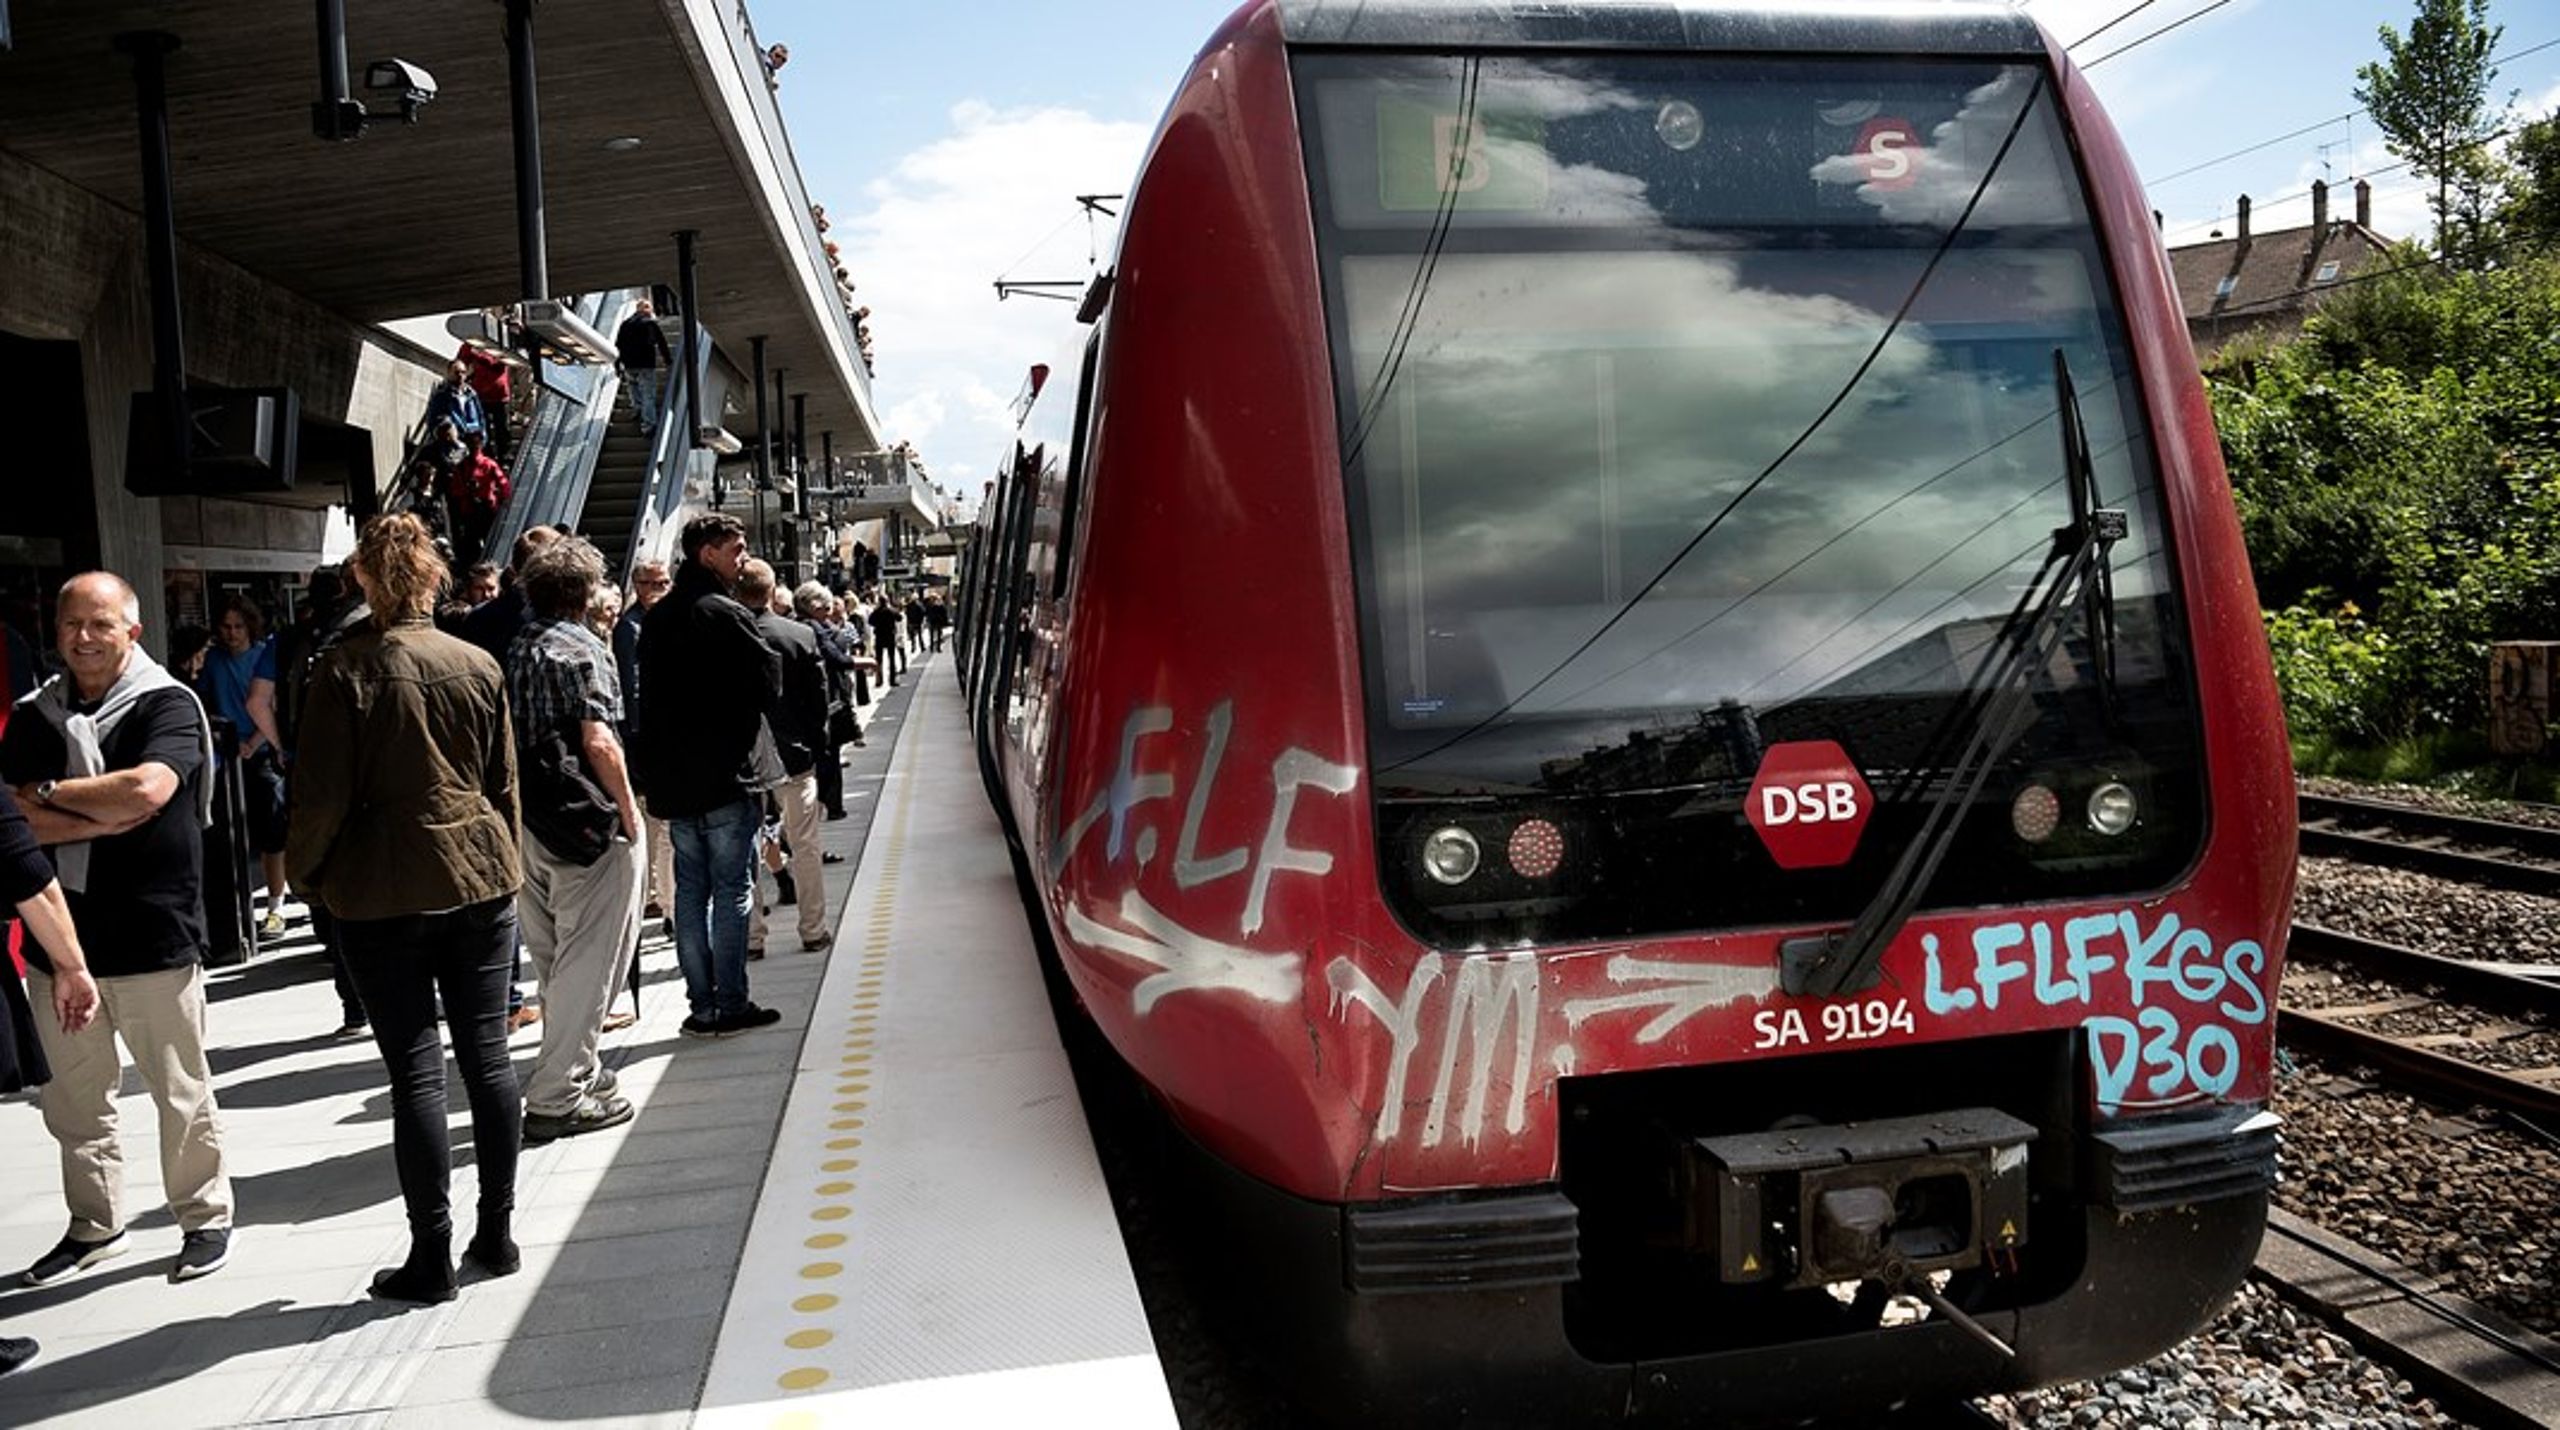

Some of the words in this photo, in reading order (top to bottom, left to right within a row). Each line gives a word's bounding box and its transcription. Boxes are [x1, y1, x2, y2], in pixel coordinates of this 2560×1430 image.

[1433, 116, 1490, 192] B
[1870, 131, 1908, 178] S
[1762, 783, 1857, 826] DSB
[1922, 909, 2266, 1024] LFLFKGS
[1753, 1009, 1810, 1049] SA
[1821, 998, 1915, 1042] 9194
